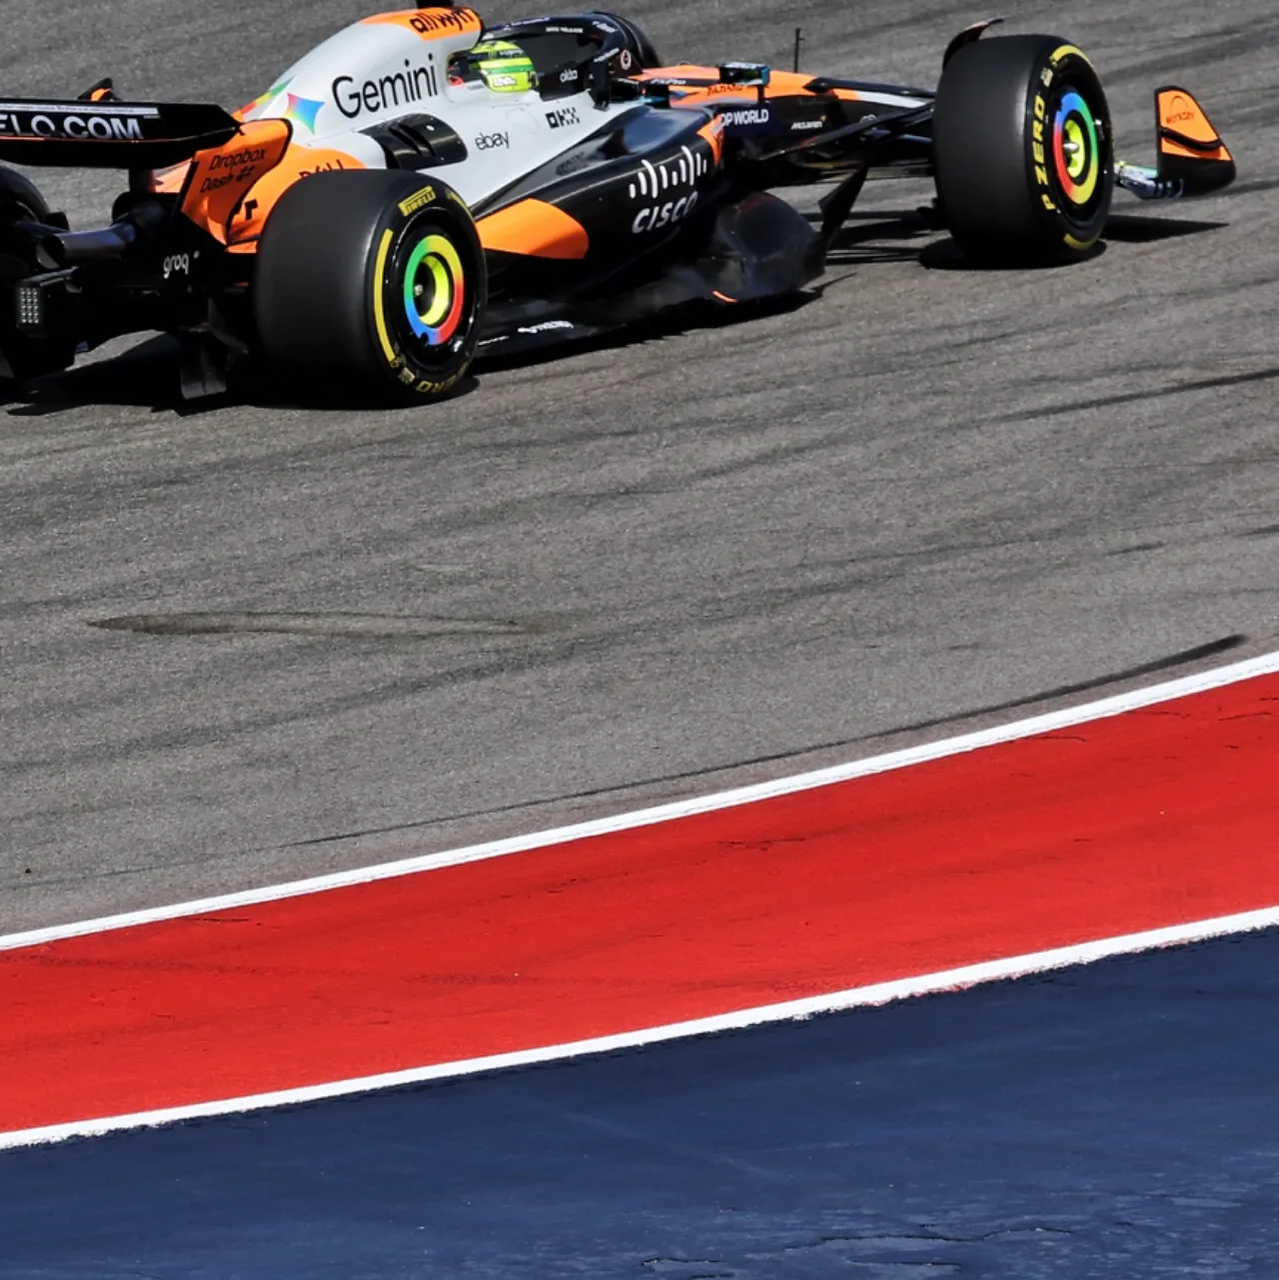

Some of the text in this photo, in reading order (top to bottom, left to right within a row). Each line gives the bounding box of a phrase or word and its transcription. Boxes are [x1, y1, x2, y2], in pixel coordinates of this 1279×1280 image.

[409, 8, 475, 33] allwyn
[331, 52, 438, 119] Gemini
[545, 107, 581, 129] OKX
[734, 109, 769, 125] WORLD
[475, 131, 510, 150] ebay
[1033, 94, 1056, 210] P ZERO
[209, 147, 268, 170] Dropbox
[200, 174, 233, 194] Dash
[397, 185, 436, 217] PIRELLI
[163, 252, 189, 279] groq
